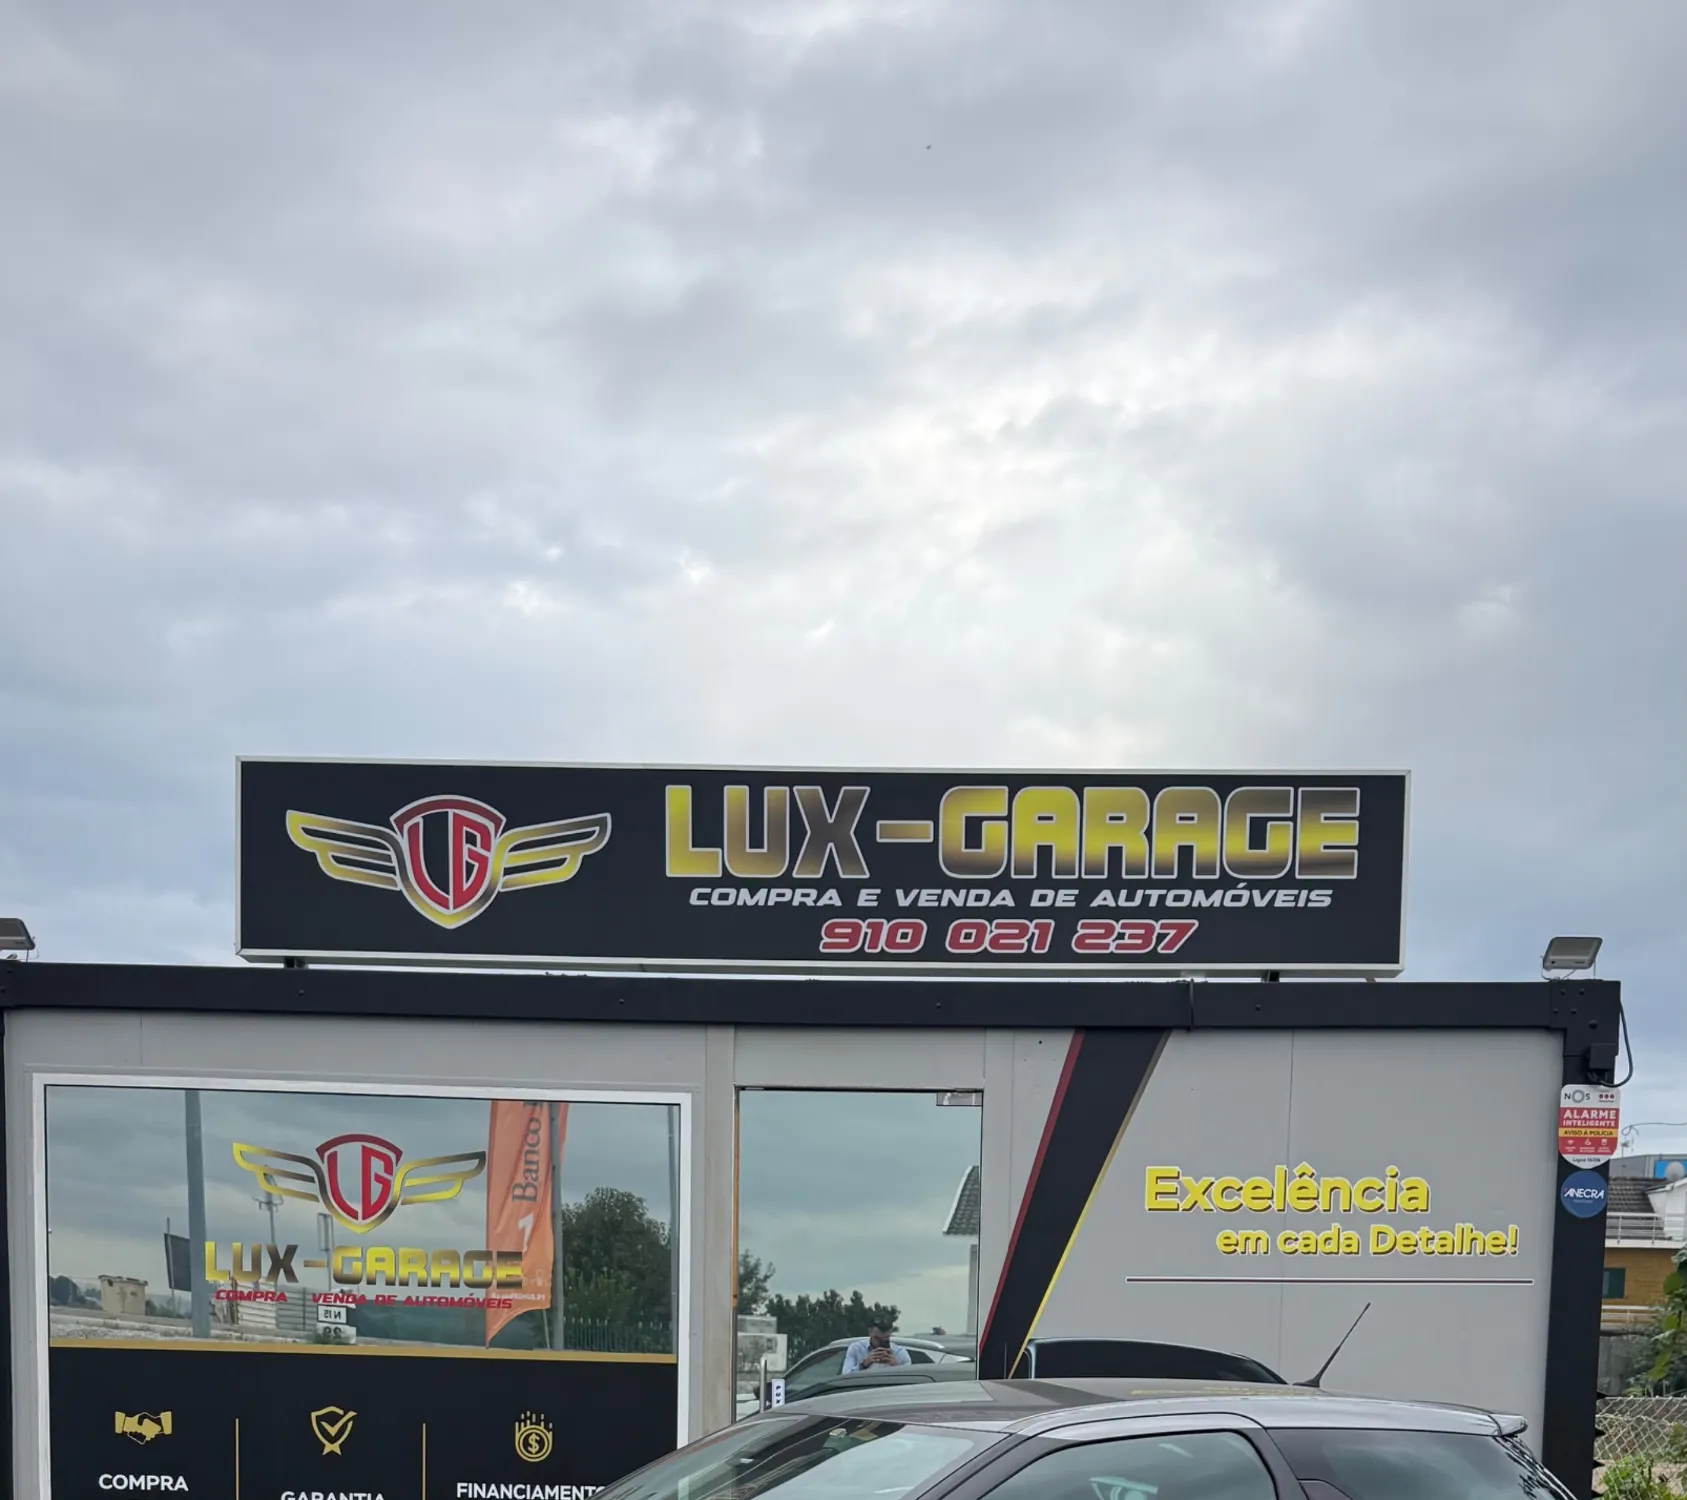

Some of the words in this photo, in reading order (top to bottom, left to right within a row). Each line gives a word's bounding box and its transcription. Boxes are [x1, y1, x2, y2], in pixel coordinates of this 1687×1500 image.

[665, 785, 1361, 879] LUX-GARAGE
[689, 887, 842, 907] COMPRA
[857, 888, 882, 906] E
[896, 888, 1016, 907] VENDA
[1030, 888, 1080, 907] DE
[1090, 882, 1333, 908] AUTOMÓVEIS
[818, 918, 926, 953] 910
[945, 918, 1056, 954] 021
[1071, 919, 1199, 954] 237
[1564, 1089, 1591, 1103] NOS
[1563, 1109, 1616, 1119] ALARME
[1563, 1119, 1616, 1127] INTELIGENTE
[511, 1116, 542, 1203] Banco
[1144, 1162, 1430, 1213] Excelência
[1564, 1188, 1605, 1199] ANECRA
[1216, 1228, 1270, 1256] em
[1276, 1222, 1360, 1256] cada
[1369, 1222, 1520, 1257] Detalhe!
[215, 1290, 288, 1303] COMPRA
[312, 1292, 367, 1305] VENDA
[374, 1294, 398, 1306] DE
[402, 1292, 512, 1309] AUTOMÓVEIS
[98, 1474, 189, 1491] COMPRA
[456, 1482, 606, 1500] FINANCIAMENT
